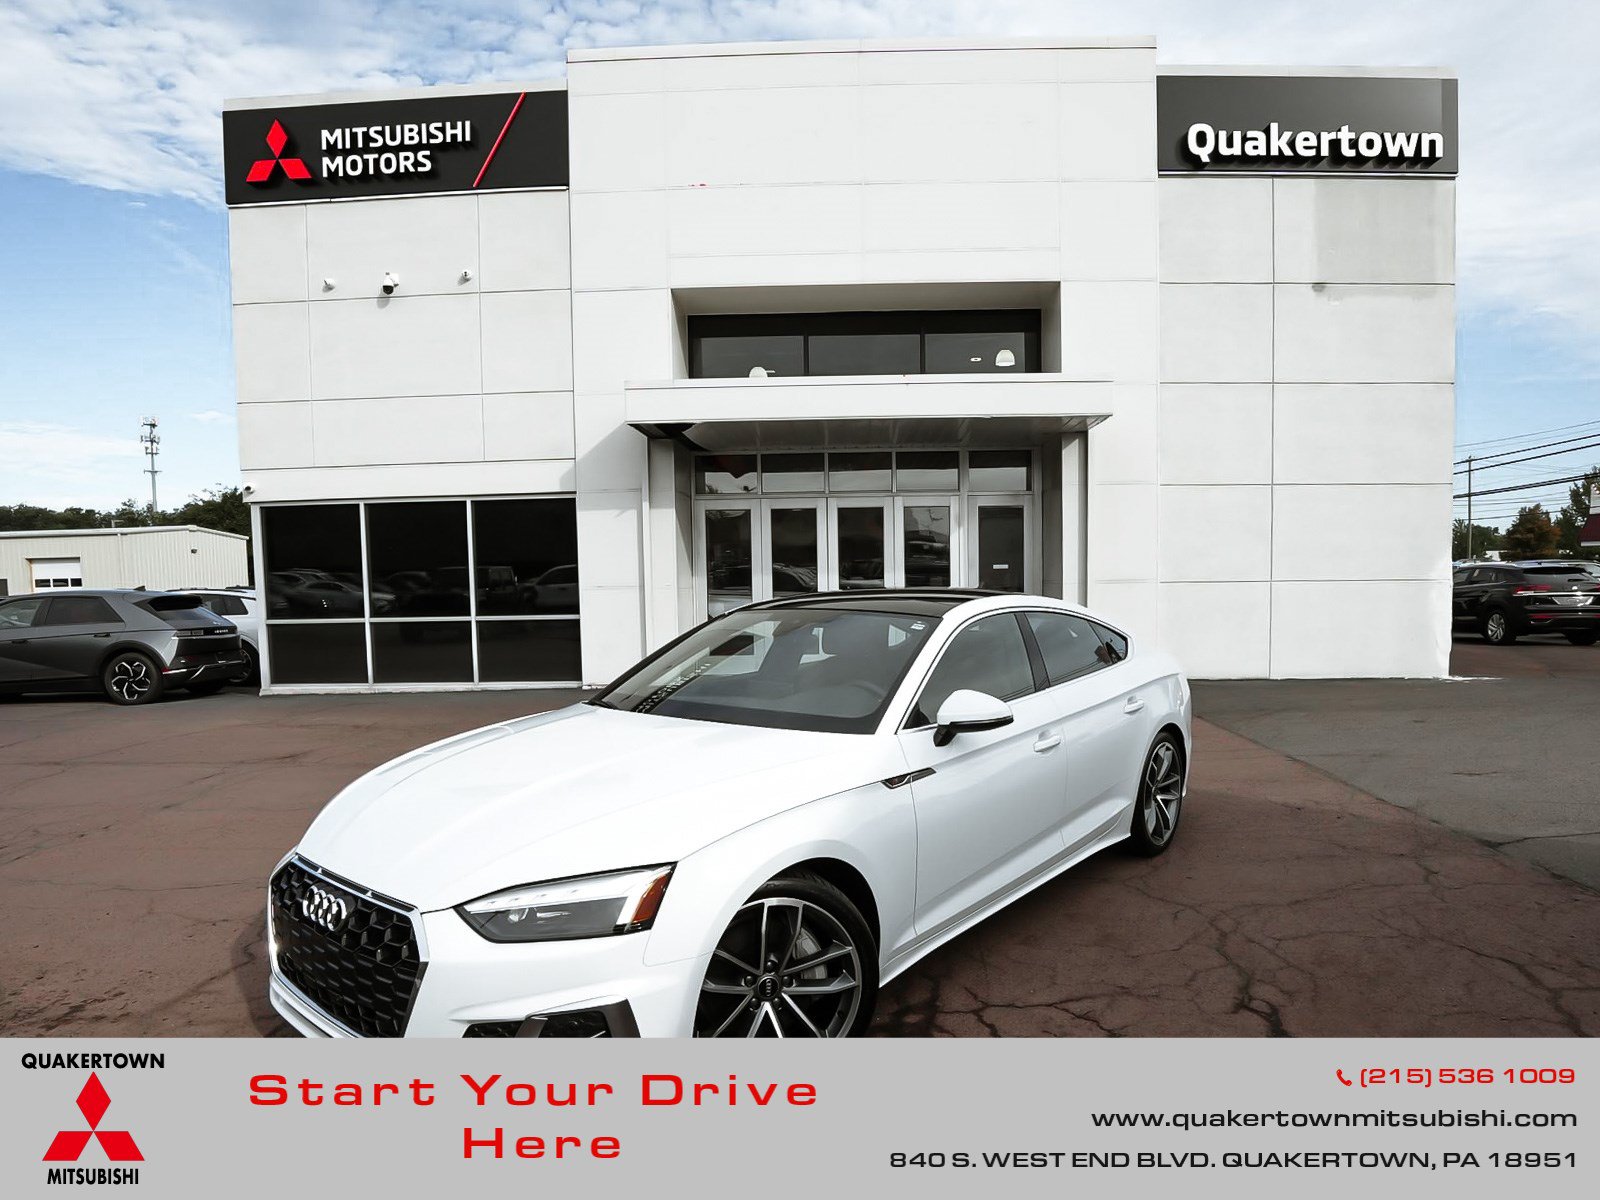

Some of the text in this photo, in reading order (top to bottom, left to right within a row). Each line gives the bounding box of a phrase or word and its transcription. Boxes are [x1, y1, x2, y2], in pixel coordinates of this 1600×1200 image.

[321, 119, 471, 151] MITSUBISHI
[1187, 122, 1444, 163] Quakertown
[321, 150, 432, 178] MOTORS
